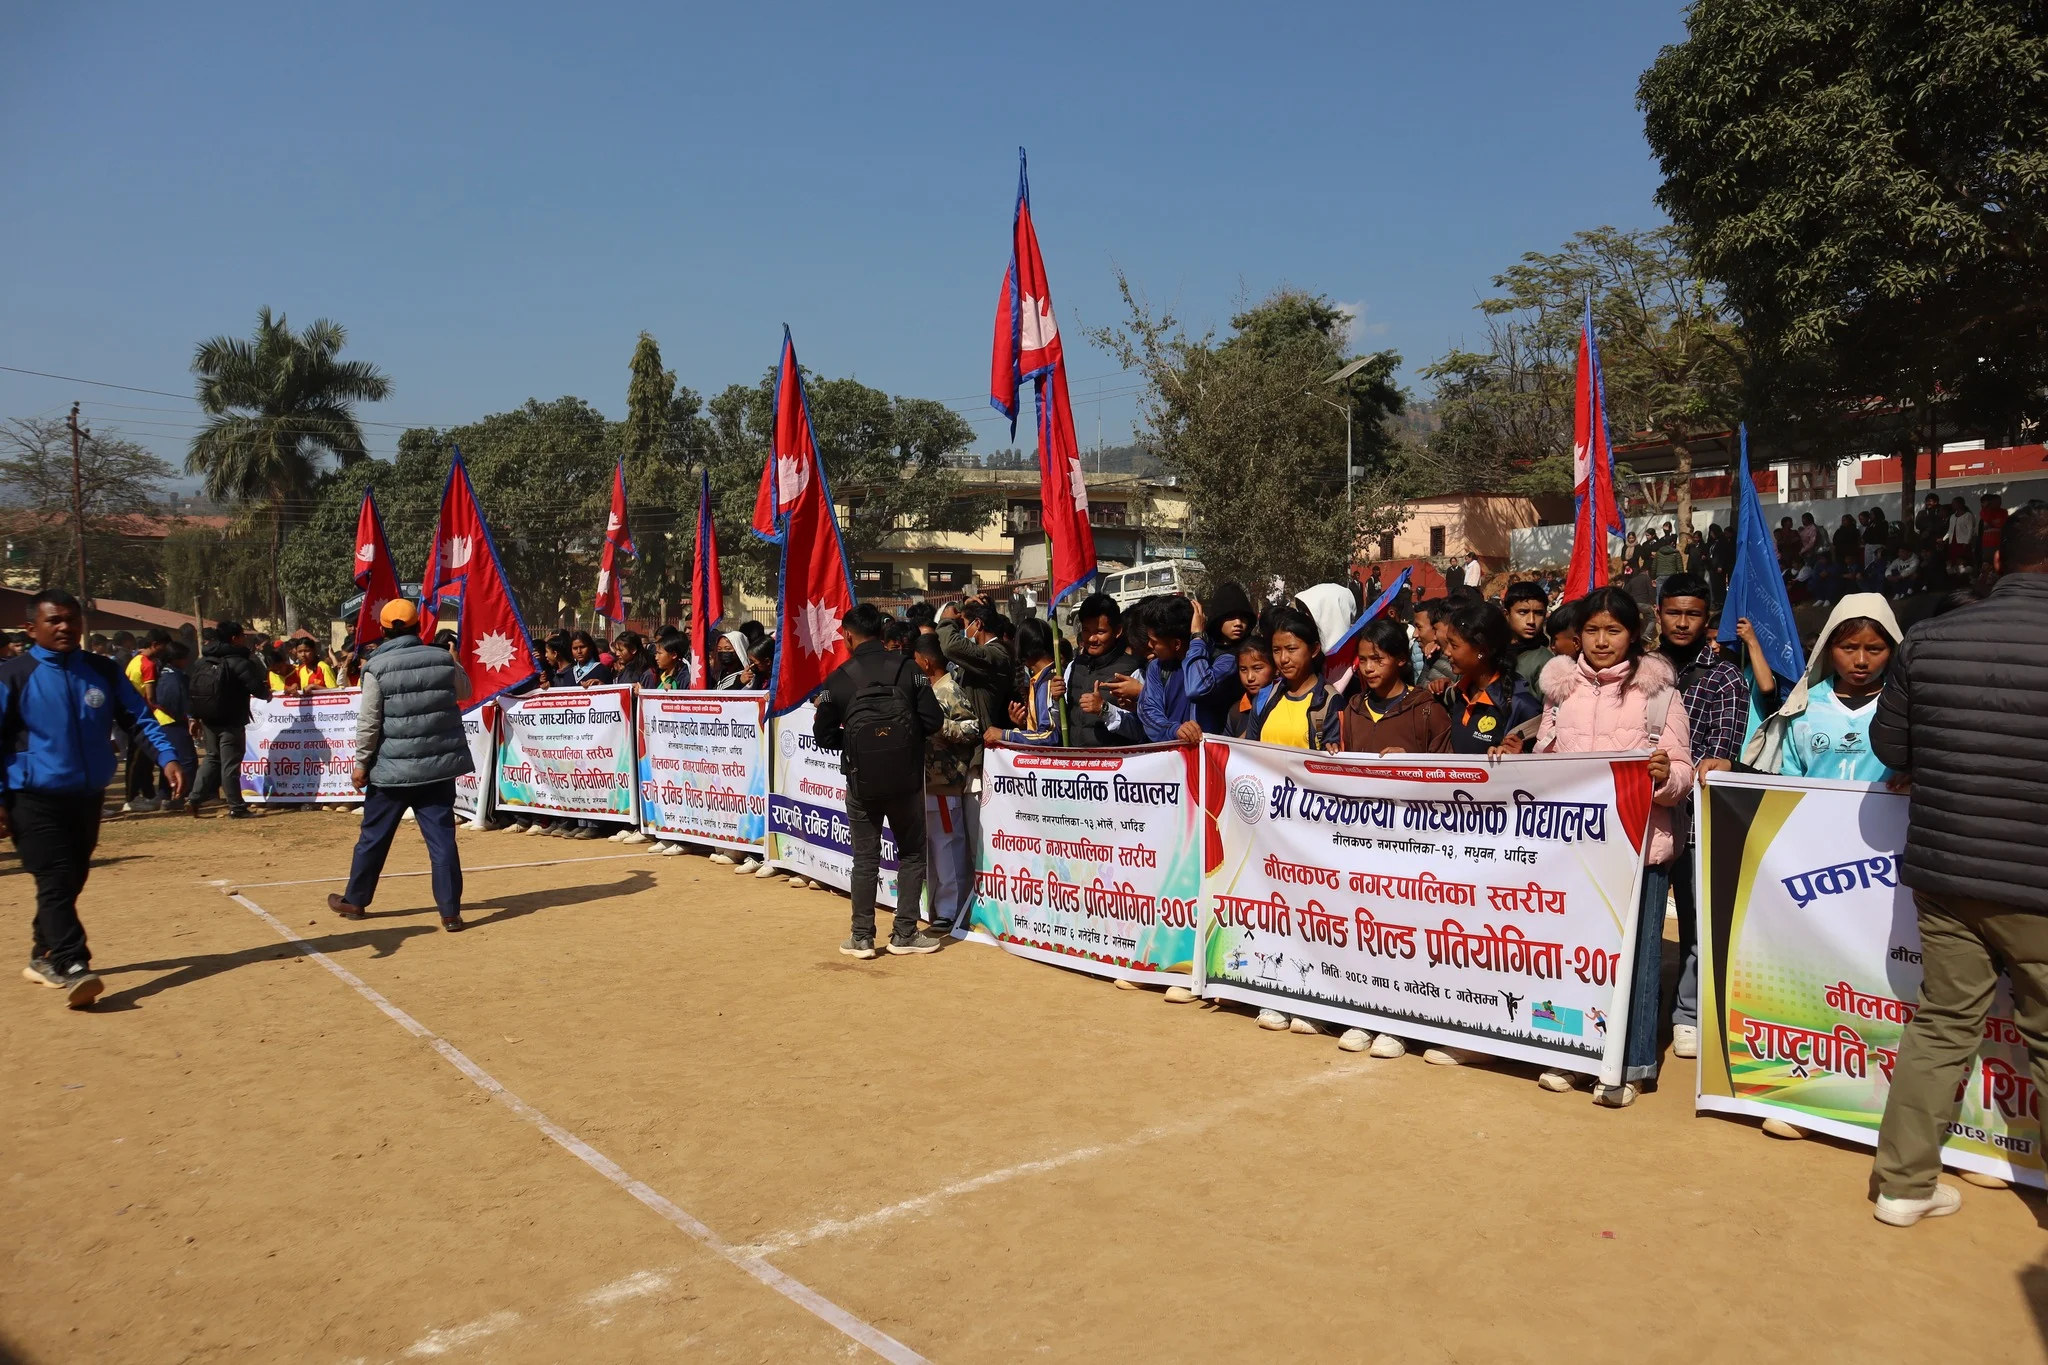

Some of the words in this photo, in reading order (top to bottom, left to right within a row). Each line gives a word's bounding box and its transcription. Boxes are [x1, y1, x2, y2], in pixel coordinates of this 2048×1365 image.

[539, 708, 585, 726] माध्यमिक
[588, 708, 621, 724] विद्यालय
[731, 718, 756, 739] विद्यालय
[586, 746, 613, 760] स्तरीय
[722, 761, 745, 777] स्तरीय
[1426, 768, 1446, 779] लागि
[1838, 758, 1856, 780] 11
[800, 777, 834, 799] नीलकण्ठ
[1041, 772, 1108, 802] माध्यमिक
[1113, 774, 1181, 806] विद्यालय
[772, 805, 803, 832] राष्ट्रपति
[805, 810, 830, 837] रनिङ
[1015, 810, 1039, 823] नीलकण्ठ
[1120, 819, 1146, 832] धादिङ
[1270, 776, 1297, 819] श्री
[1300, 789, 1396, 828] पञ्चकन्या
[1400, 789, 1507, 835] माध्यमिक
[1512, 789, 1608, 842] विद्यालय
[991, 829, 1041, 854] नीलकण्ठ
[1045, 837, 1113, 863] नगरपालिका
[1118, 843, 1156, 869] स्तरीय
[1332, 832, 1372, 849] नीलकण्ठ
[1377, 838, 1458, 860] नगरपालिका-१३,
[1504, 846, 1539, 864] धादिङ
[1011, 867, 1044, 906] रनिङ
[1048, 871, 1080, 912] शिल्ड
[1263, 854, 1340, 890] नीलकण्ठ
[1349, 872, 1476, 907] नगरपालिका
[1486, 882, 1567, 915] स्तरीय
[1033, 922, 1051, 937] २०८२
[1213, 891, 1291, 941] राष्ट्रपति
[1296, 900, 1349, 948] रनिङ
[1355, 907, 1417, 959] शिल्ड
[1345, 971, 1368, 985] २०८२
[1371, 975, 1390, 989] माघ
[1393, 980, 1400, 992] ६
[1404, 980, 1440, 998] गतेदेखि
[1445, 989, 1451, 999] ८
[1456, 989, 1498, 1007] गतेसम्म
[1744, 1020, 1867, 1078] राष्ट्रपति
[1994, 1134, 2031, 1154] माघ
